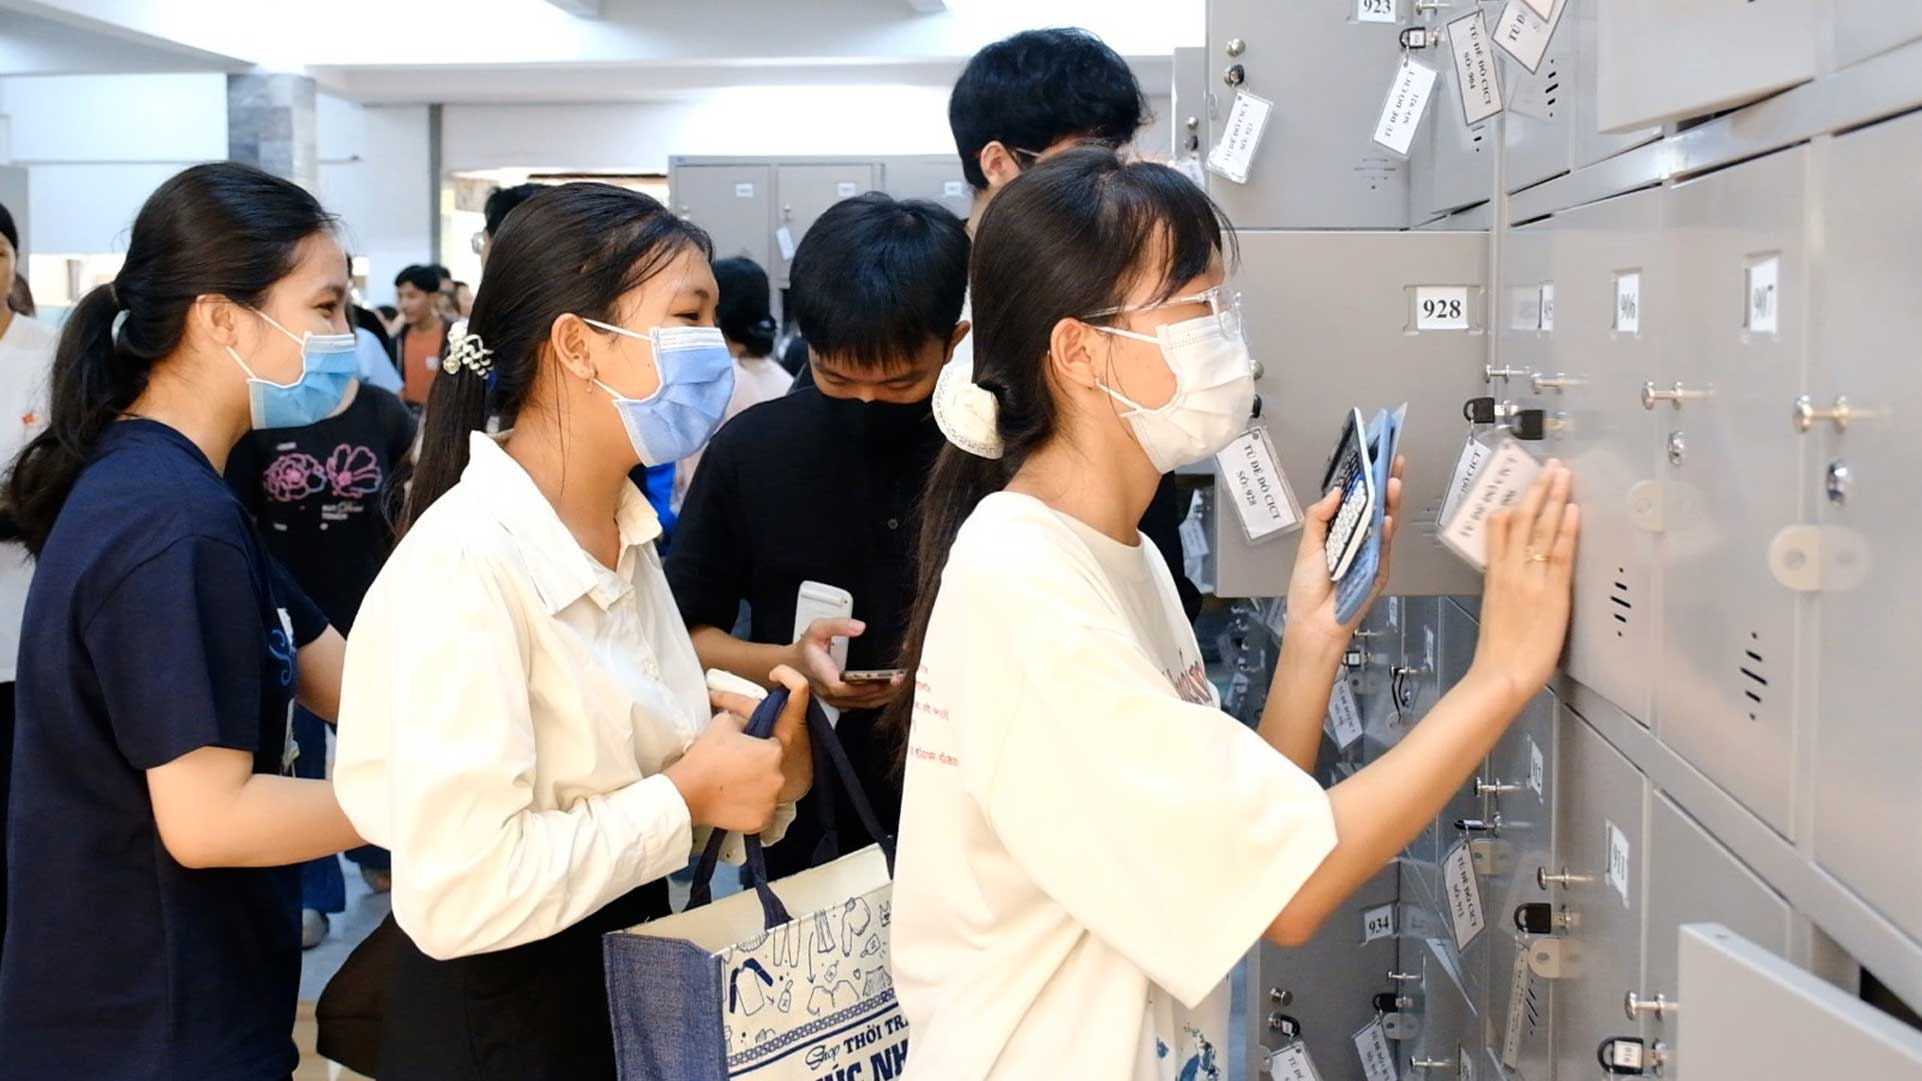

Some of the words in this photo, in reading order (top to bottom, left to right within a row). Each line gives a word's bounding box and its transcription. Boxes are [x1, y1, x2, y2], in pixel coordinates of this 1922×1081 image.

[1364, 0, 1391, 14] 923
[1422, 299, 1462, 319] 928
[1246, 489, 1257, 506] 928
[1264, 494, 1280, 519] CICT
[1369, 916, 1390, 934] 934
